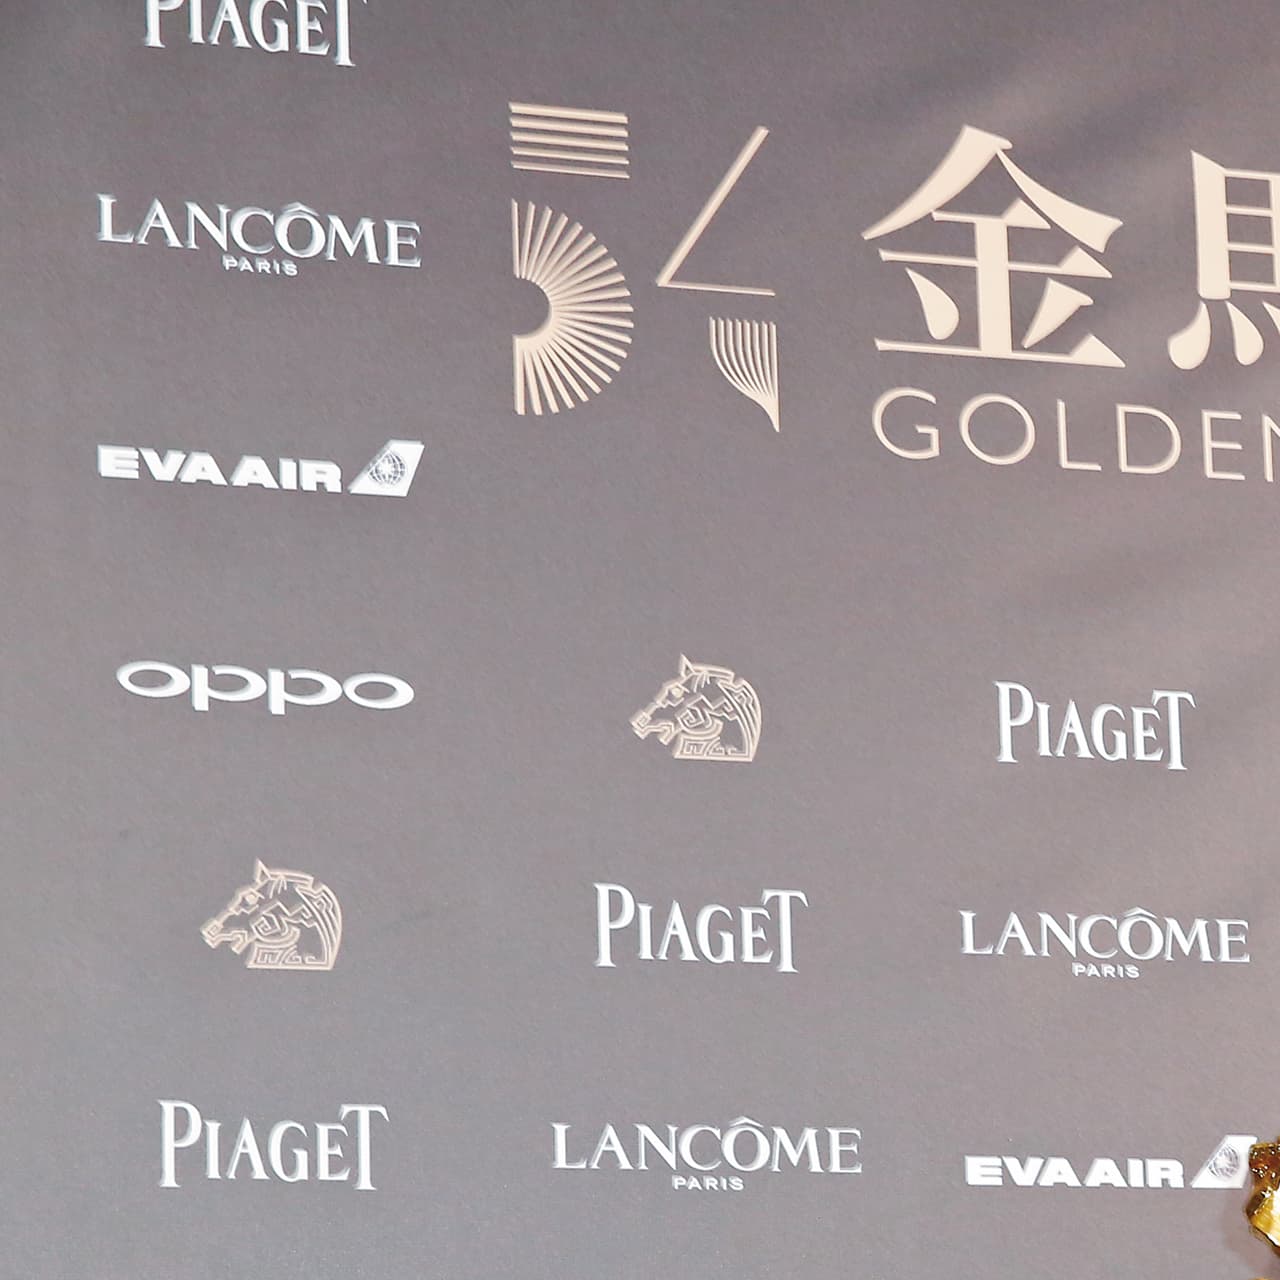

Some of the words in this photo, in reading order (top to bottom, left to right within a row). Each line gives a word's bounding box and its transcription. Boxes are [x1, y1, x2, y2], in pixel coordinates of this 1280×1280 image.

[98, 194, 420, 267] LANCÔME
[223, 255, 297, 275] PARIS
[117, 662, 414, 714] oppo
[996, 682, 1195, 769] PIAGET
[595, 884, 808, 972] PIAGET
[960, 907, 1250, 962] LANCÔME
[1072, 963, 1139, 978] PARIS
[160, 1101, 389, 1190] PIAGET
[552, 1117, 862, 1173] LANCÔME
[672, 1176, 743, 1190] PARIS
